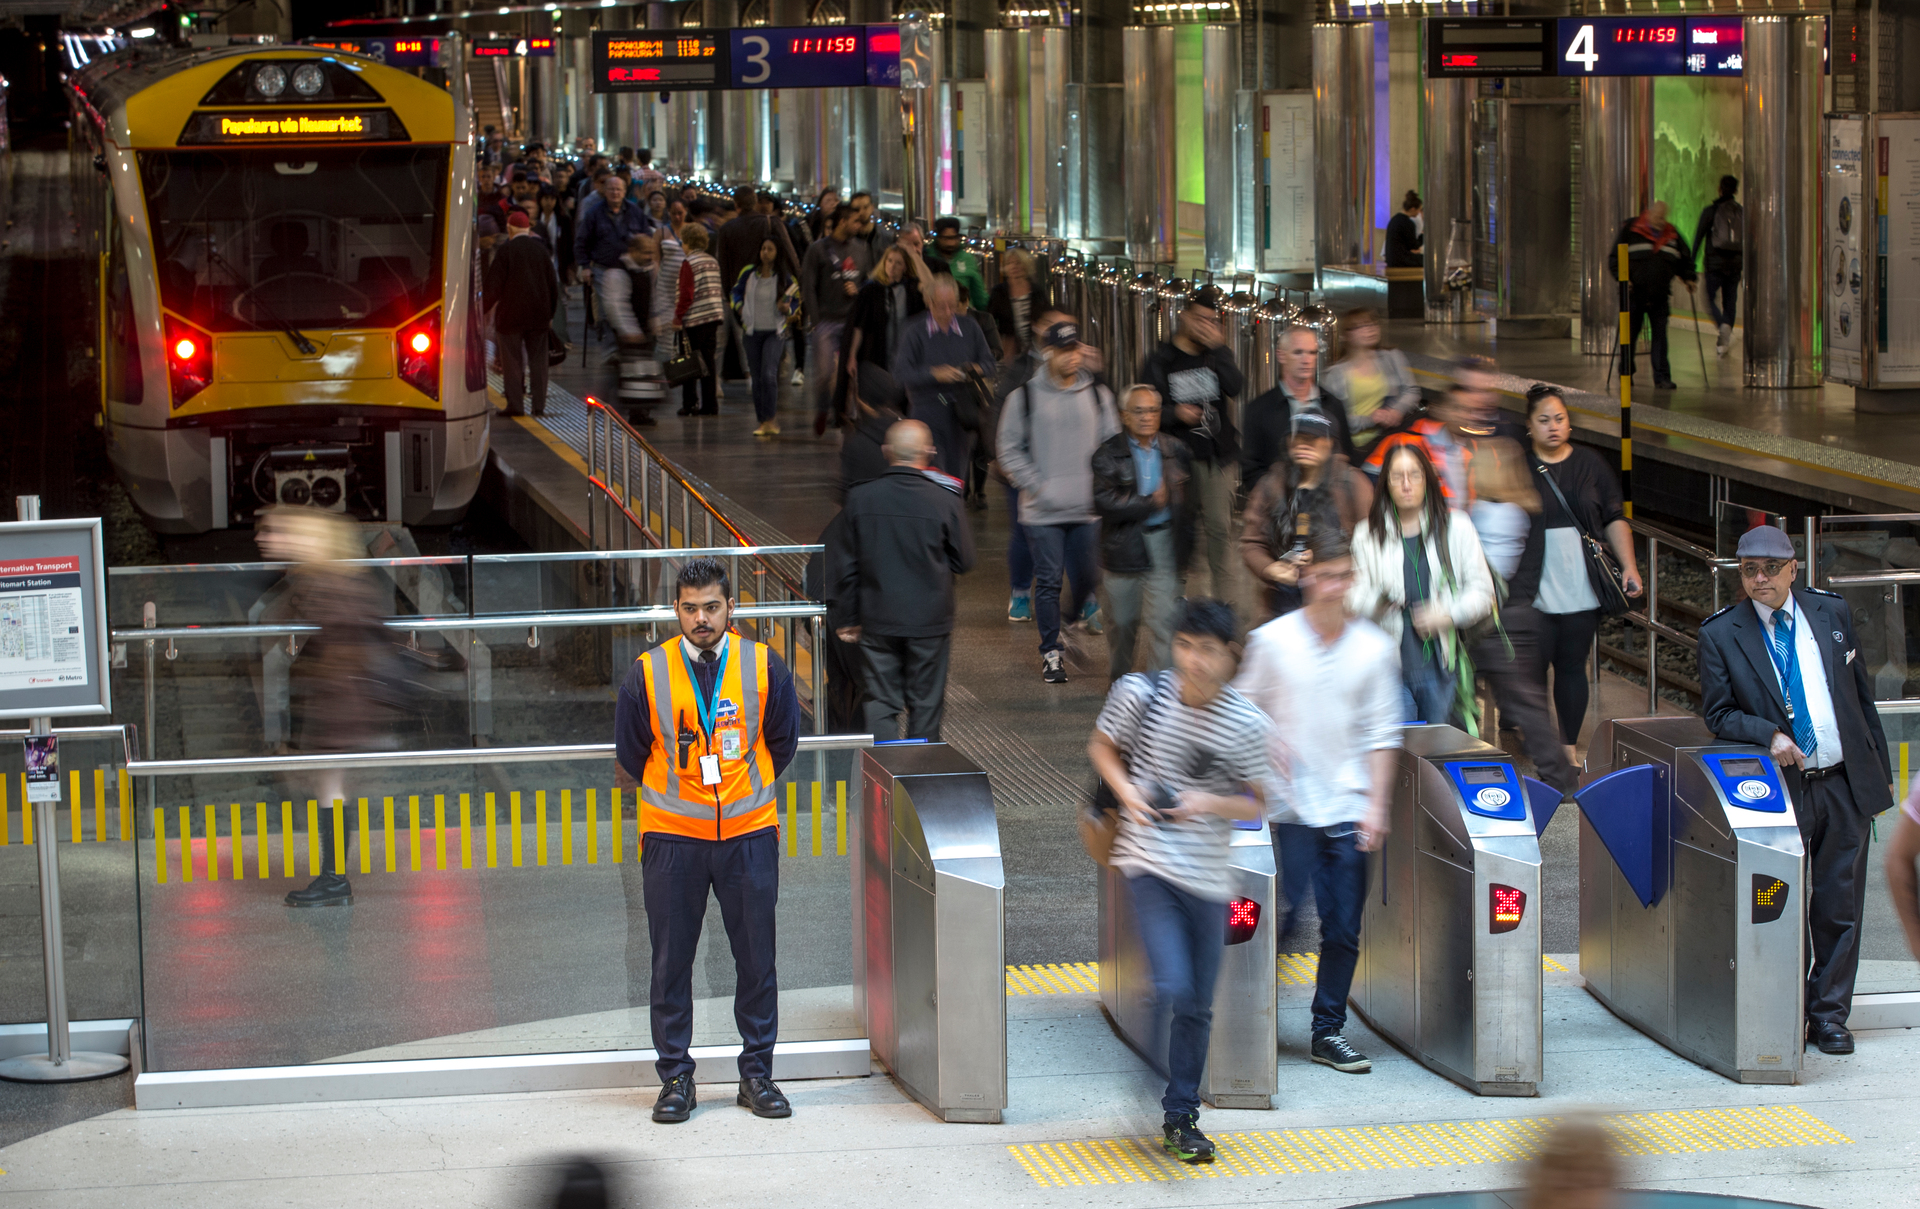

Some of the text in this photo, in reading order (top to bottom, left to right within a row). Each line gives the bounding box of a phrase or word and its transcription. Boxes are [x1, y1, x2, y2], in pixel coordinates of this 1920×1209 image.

[1616, 27, 1677, 43] 11:11:59
[515, 40, 528, 56] 4
[677, 39, 700, 49] 1118
[703, 46, 716, 57] 27
[792, 36, 856, 54] 11:11:59
[1565, 24, 1599, 72] 4
[742, 35, 771, 84] 3
[222, 116, 363, 136] Papakura via Newmarket
[36, 561, 72, 571] Transport
[0, 578, 52, 588] itomart Station
[714, 717, 741, 728] SECUITY
